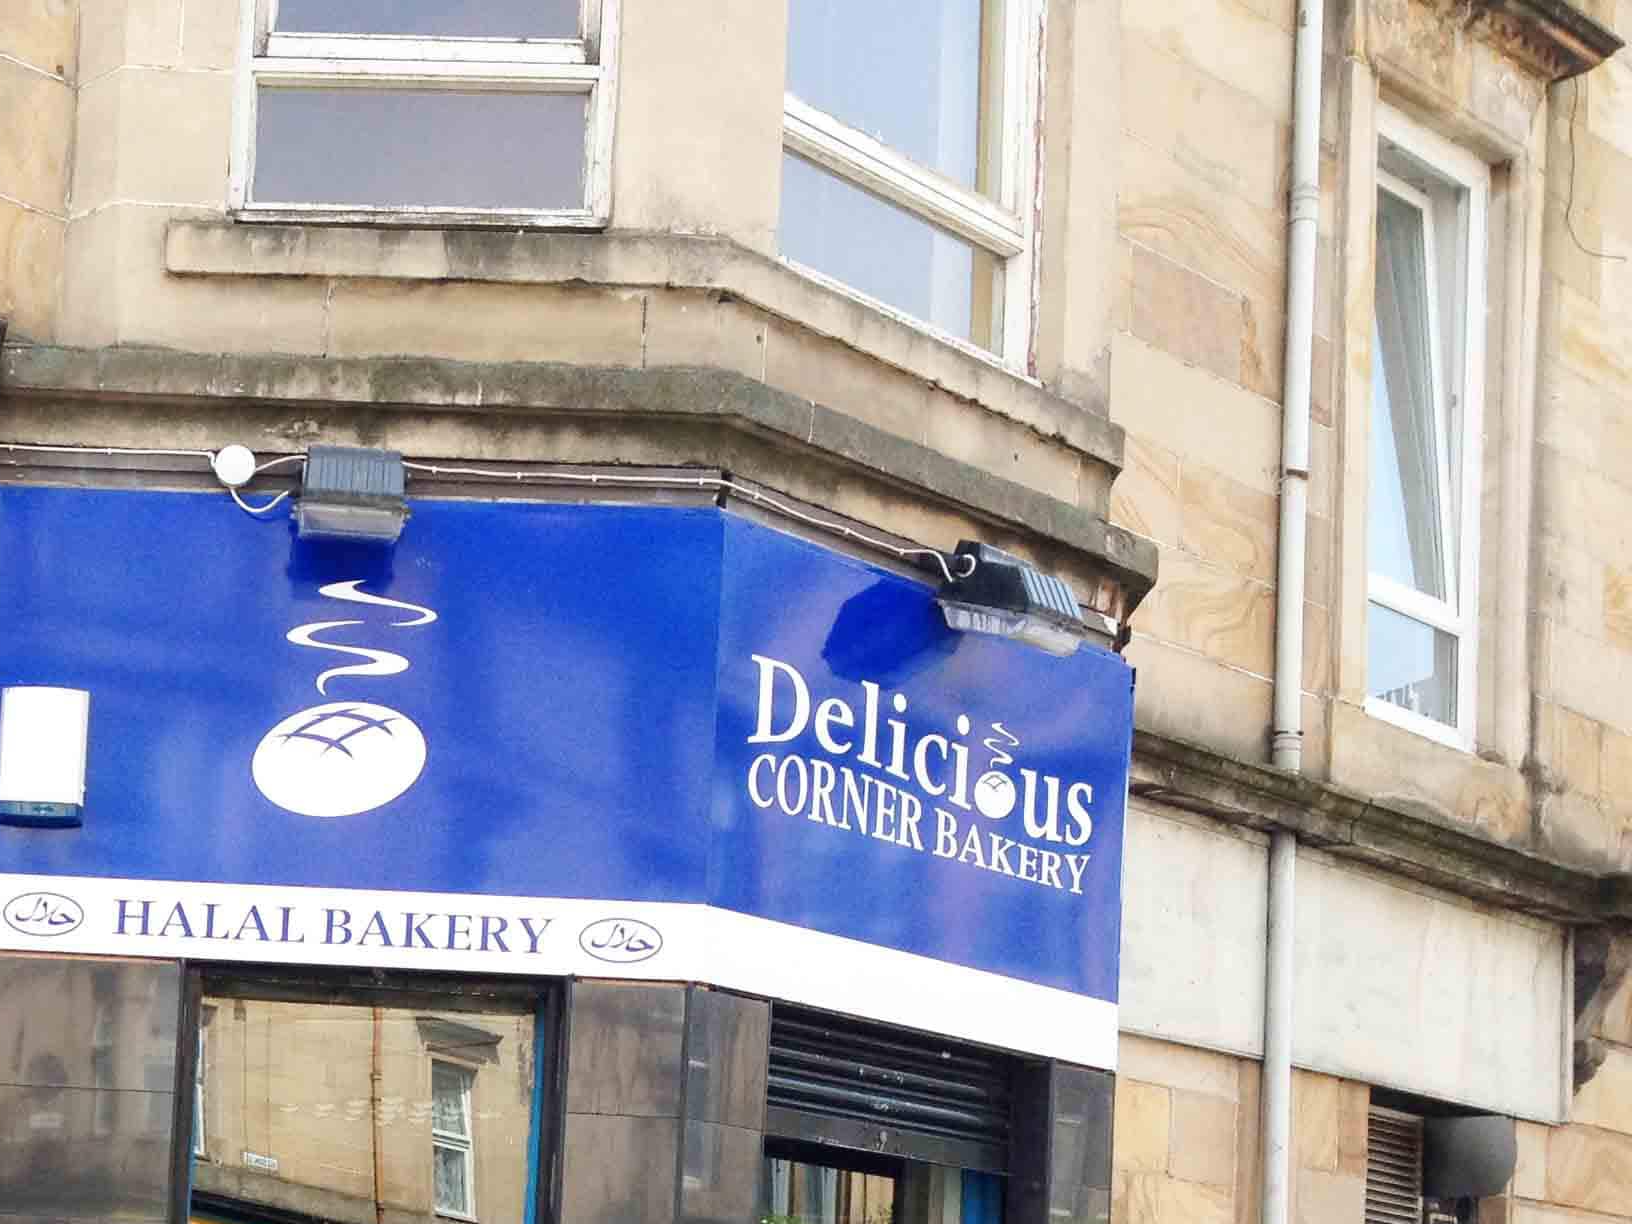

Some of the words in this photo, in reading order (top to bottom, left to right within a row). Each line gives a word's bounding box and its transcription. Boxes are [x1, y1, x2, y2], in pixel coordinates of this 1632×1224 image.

[747, 654, 1093, 846] Delicious
[748, 753, 924, 851] CORNER
[933, 807, 1091, 895] BAKERY
[113, 898, 306, 943] HALAL
[320, 907, 555, 955] BAKERY
